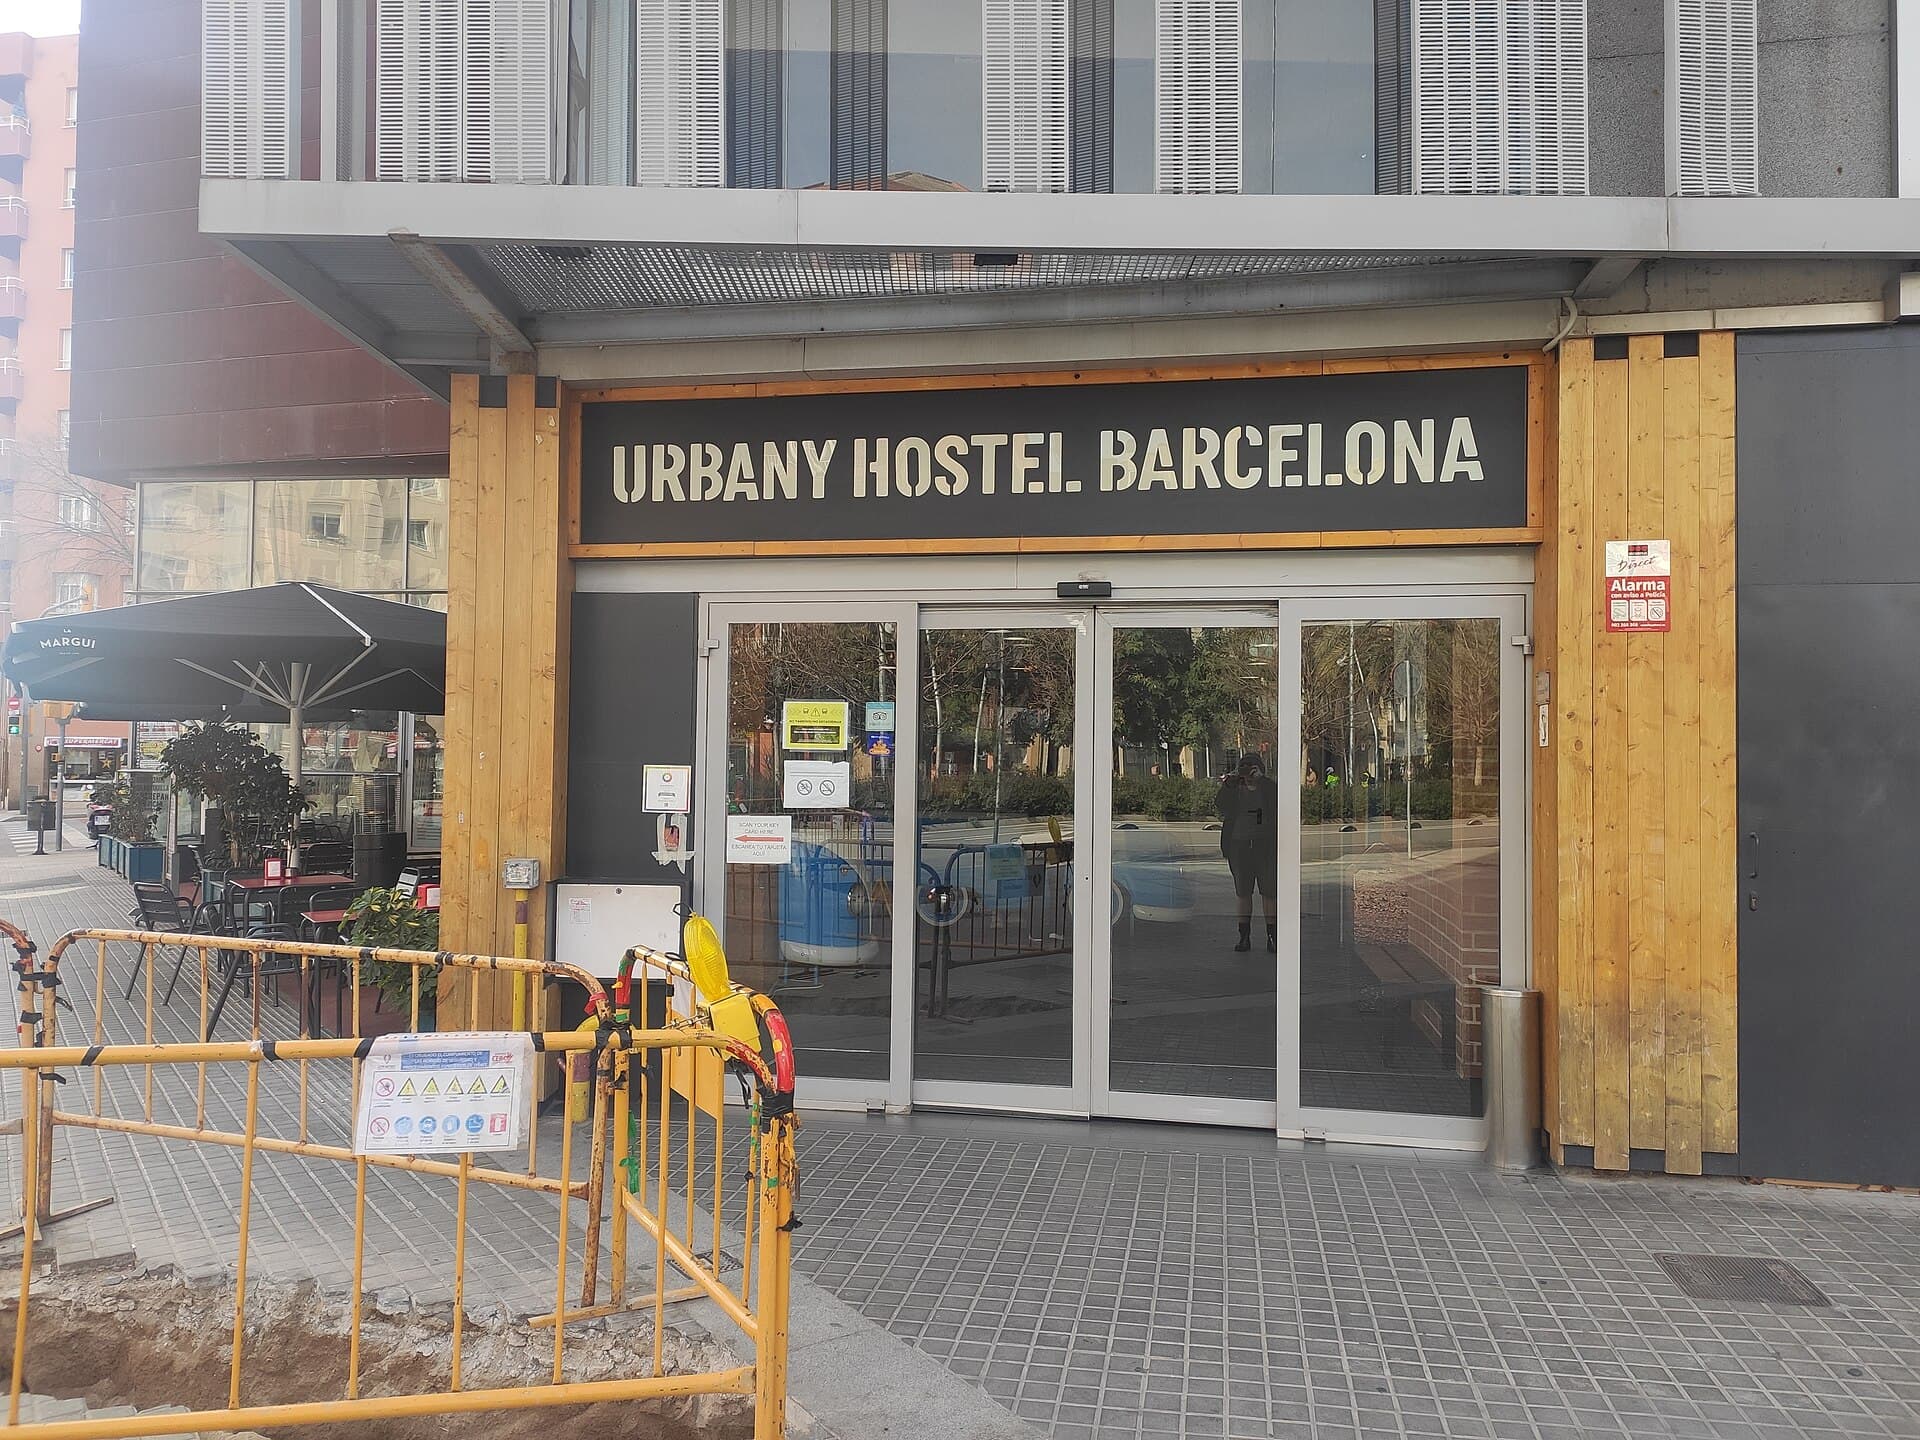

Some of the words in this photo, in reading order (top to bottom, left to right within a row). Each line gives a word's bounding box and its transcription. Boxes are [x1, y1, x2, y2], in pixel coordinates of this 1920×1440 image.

[613, 439, 838, 503] URBANY
[853, 431, 1082, 498] HOSTEL
[1099, 416, 1485, 491] BARCELONA
[1611, 579, 1666, 591] Alarma
[39, 637, 96, 649] MARGUI
